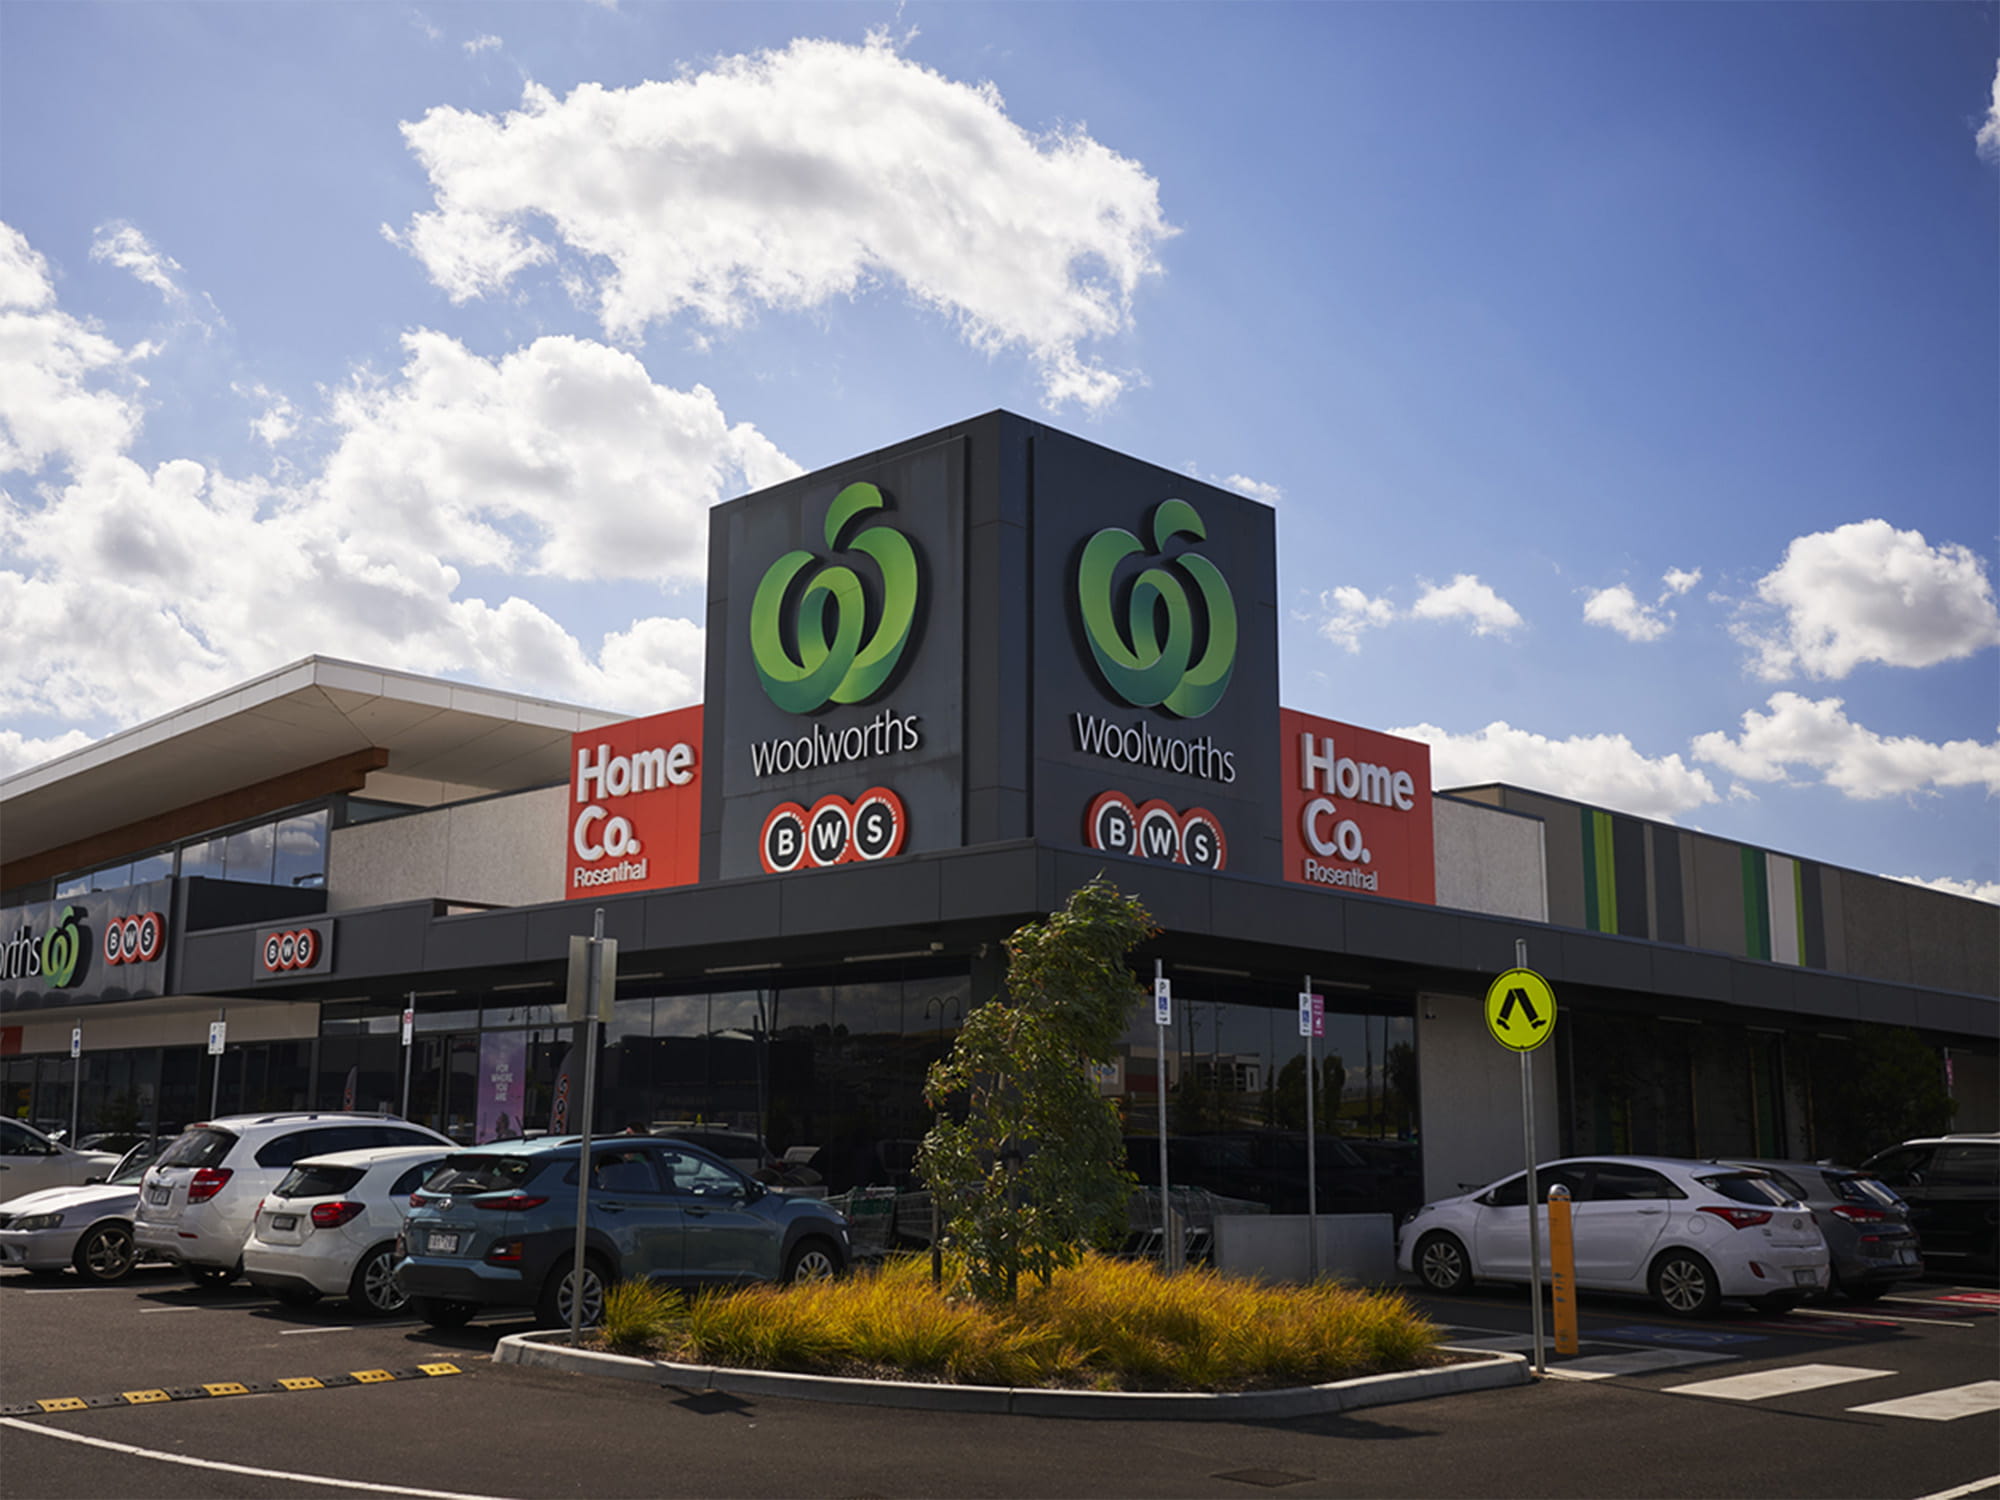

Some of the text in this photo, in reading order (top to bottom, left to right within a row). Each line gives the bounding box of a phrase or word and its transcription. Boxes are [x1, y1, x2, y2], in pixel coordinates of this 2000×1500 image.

[751, 708, 920, 777] Woolworths
[1076, 711, 1237, 784] Woolworths
[576, 742, 696, 803] Home
[1301, 732, 1415, 812] Home
[573, 805, 642, 862] Co.
[777, 814, 883, 858] BWS
[1109, 816, 1210, 862] BWS
[1302, 798, 1372, 865] Co.
[573, 858, 648, 889] Rosenthal
[1304, 857, 1379, 892] Rosenthal
[109, 927, 152, 950] BWS
[268, 940, 307, 960] BWS
